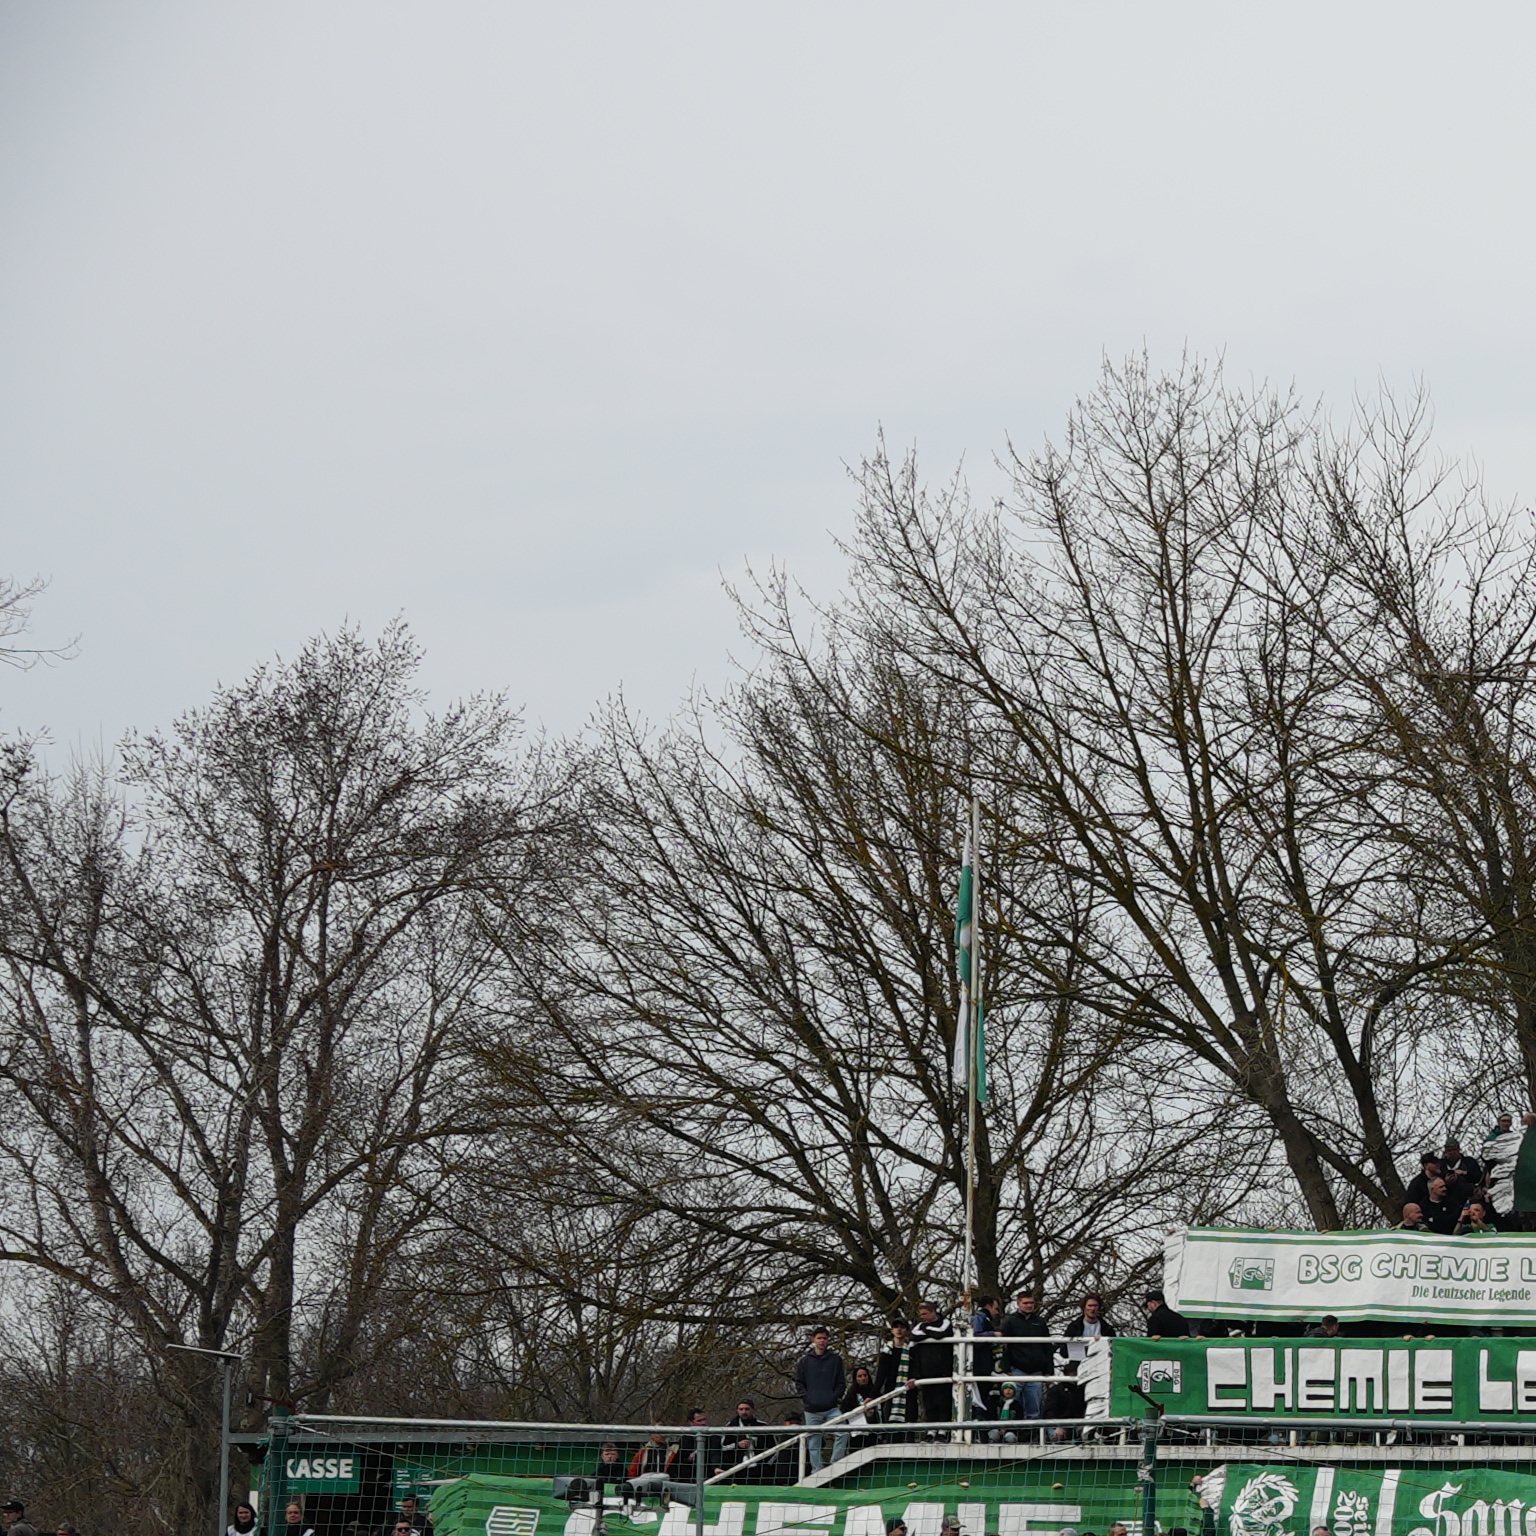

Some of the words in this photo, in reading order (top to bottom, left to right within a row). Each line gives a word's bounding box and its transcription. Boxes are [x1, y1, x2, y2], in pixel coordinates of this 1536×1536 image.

[1298, 1254, 1362, 1284] BSG
[1370, 1252, 1511, 1283] CHEMIE
[1411, 1285, 1430, 1299] Die
[1432, 1286, 1484, 1301] Leutzscher
[1487, 1286, 1531, 1302] Legende
[1206, 1347, 1453, 1412] CHEMIE
